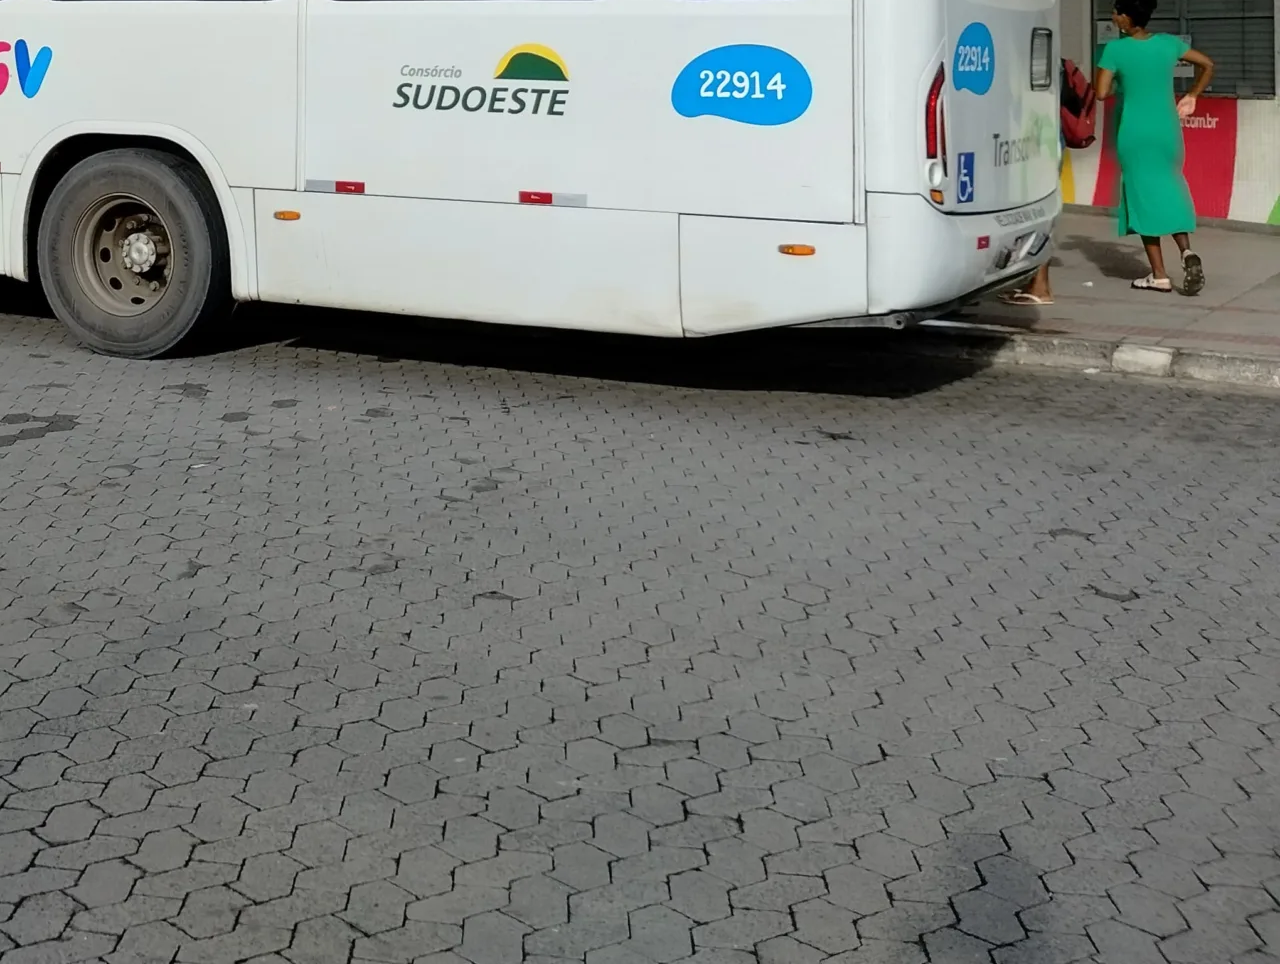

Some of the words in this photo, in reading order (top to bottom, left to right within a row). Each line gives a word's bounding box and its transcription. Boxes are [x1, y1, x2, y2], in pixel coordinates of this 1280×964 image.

[400, 65, 462, 78] Consórcio
[958, 46, 990, 71] 22914
[699, 70, 787, 100] 22914
[392, 83, 569, 116] SUDOESTE
